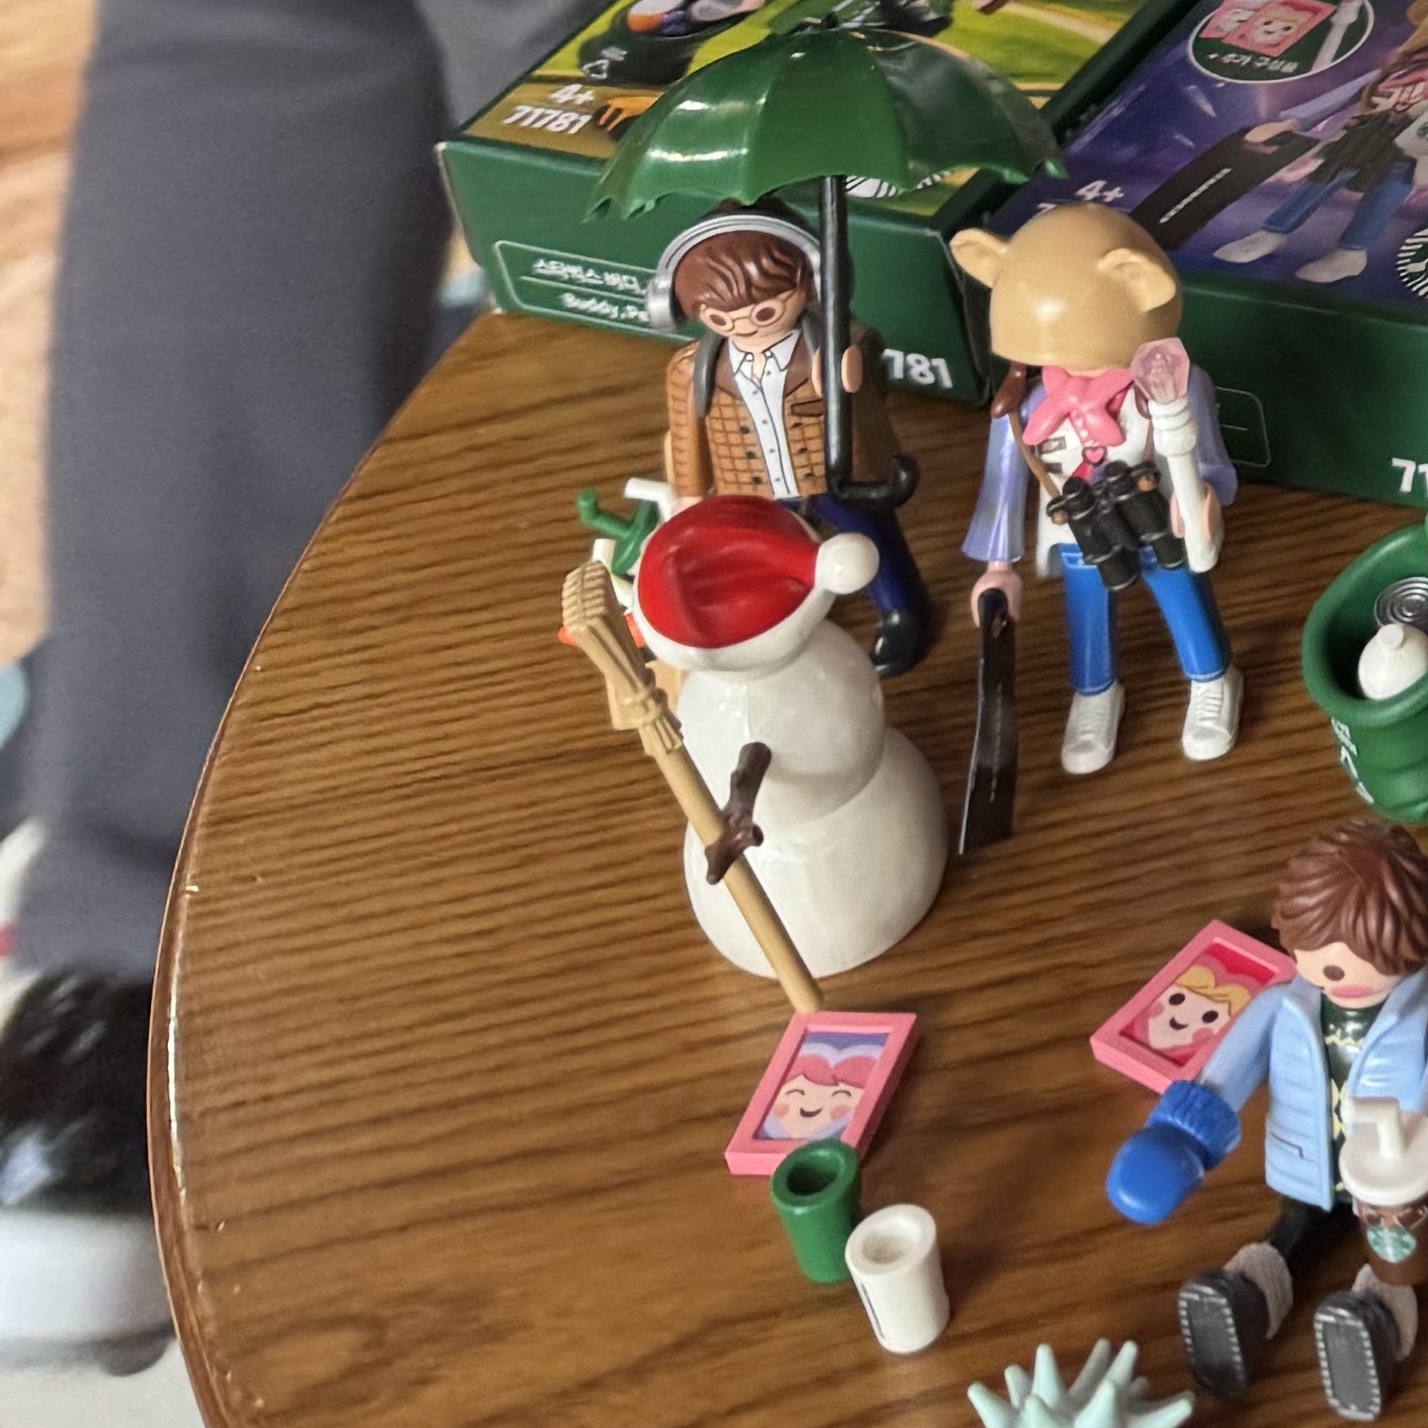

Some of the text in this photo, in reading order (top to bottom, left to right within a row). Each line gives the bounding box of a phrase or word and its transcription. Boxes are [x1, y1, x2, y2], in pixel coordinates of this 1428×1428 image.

[550, 83, 596, 107] 4+
[502, 104, 593, 135] 71781
[1076, 178, 1125, 204] 4+
[886, 347, 954, 390] 781
